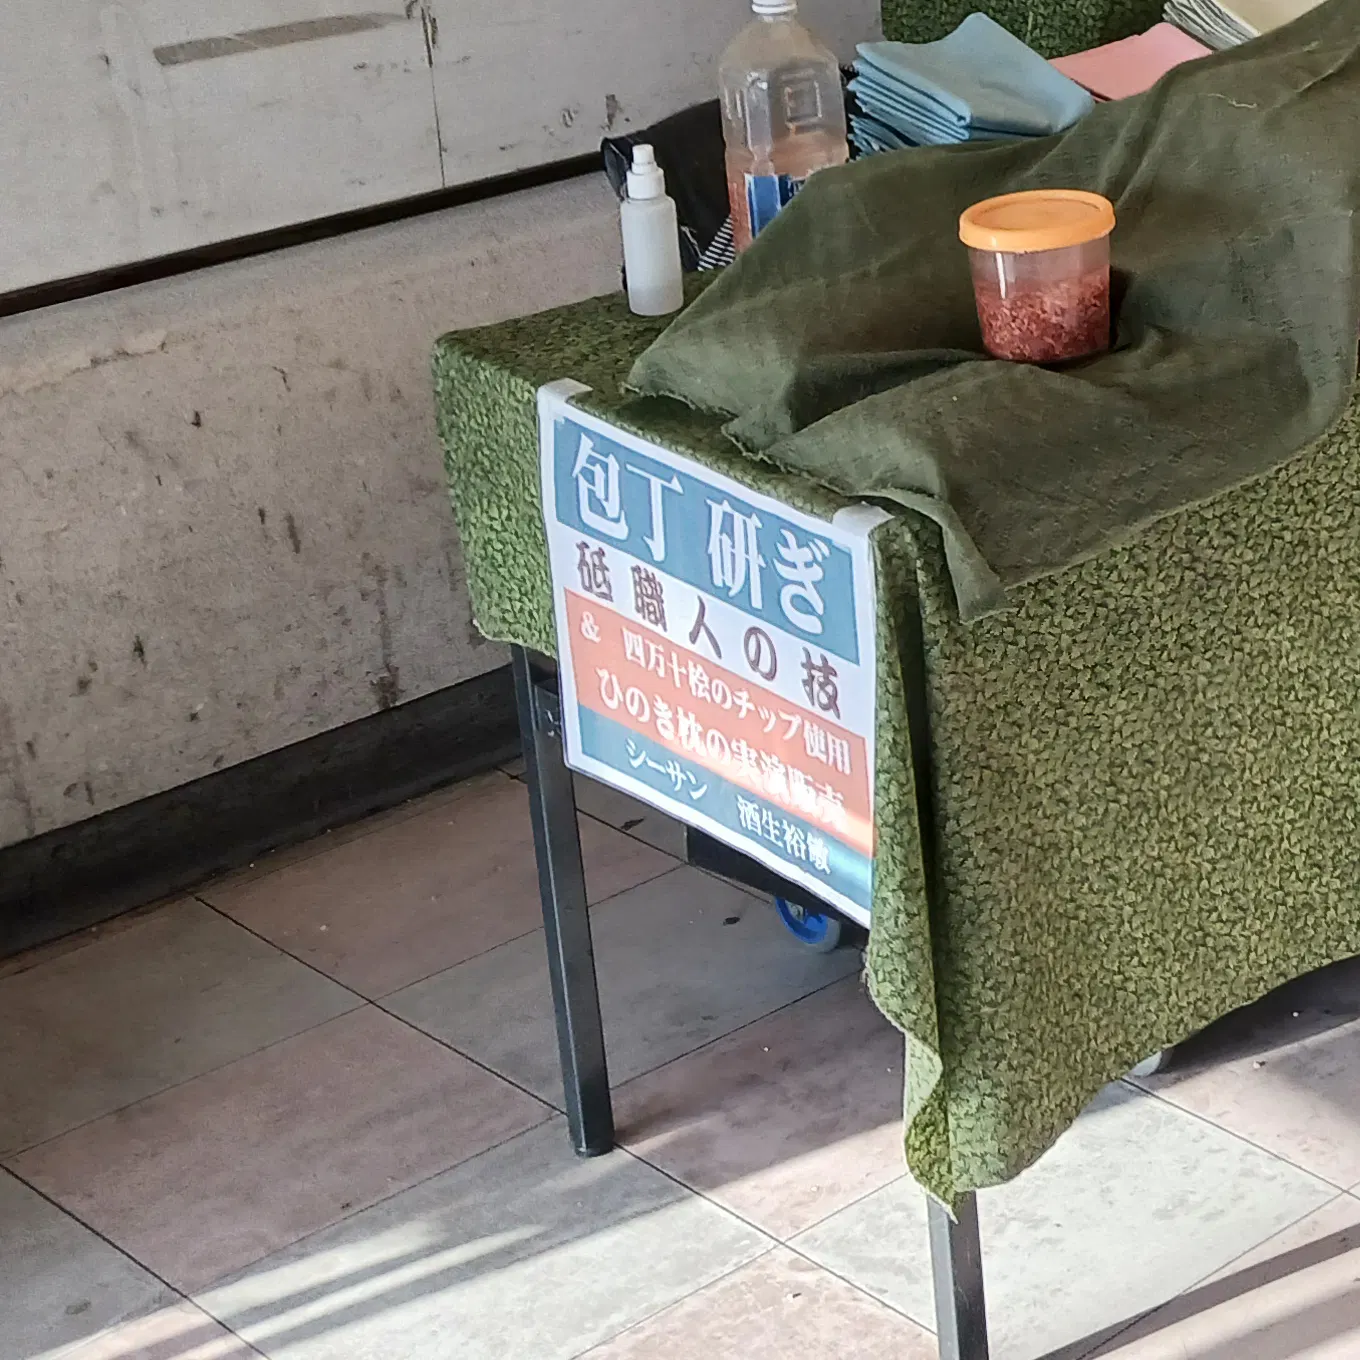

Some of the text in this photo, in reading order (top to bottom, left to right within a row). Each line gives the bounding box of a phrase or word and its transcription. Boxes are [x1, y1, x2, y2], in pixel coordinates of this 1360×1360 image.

[571, 433, 831, 635] 包丁研ぎ
[577, 541, 841, 719] 砥職人の技
[580, 611, 850, 776] & 四万十桧のチップ使用
[625, 737, 708, 801] シーサン
